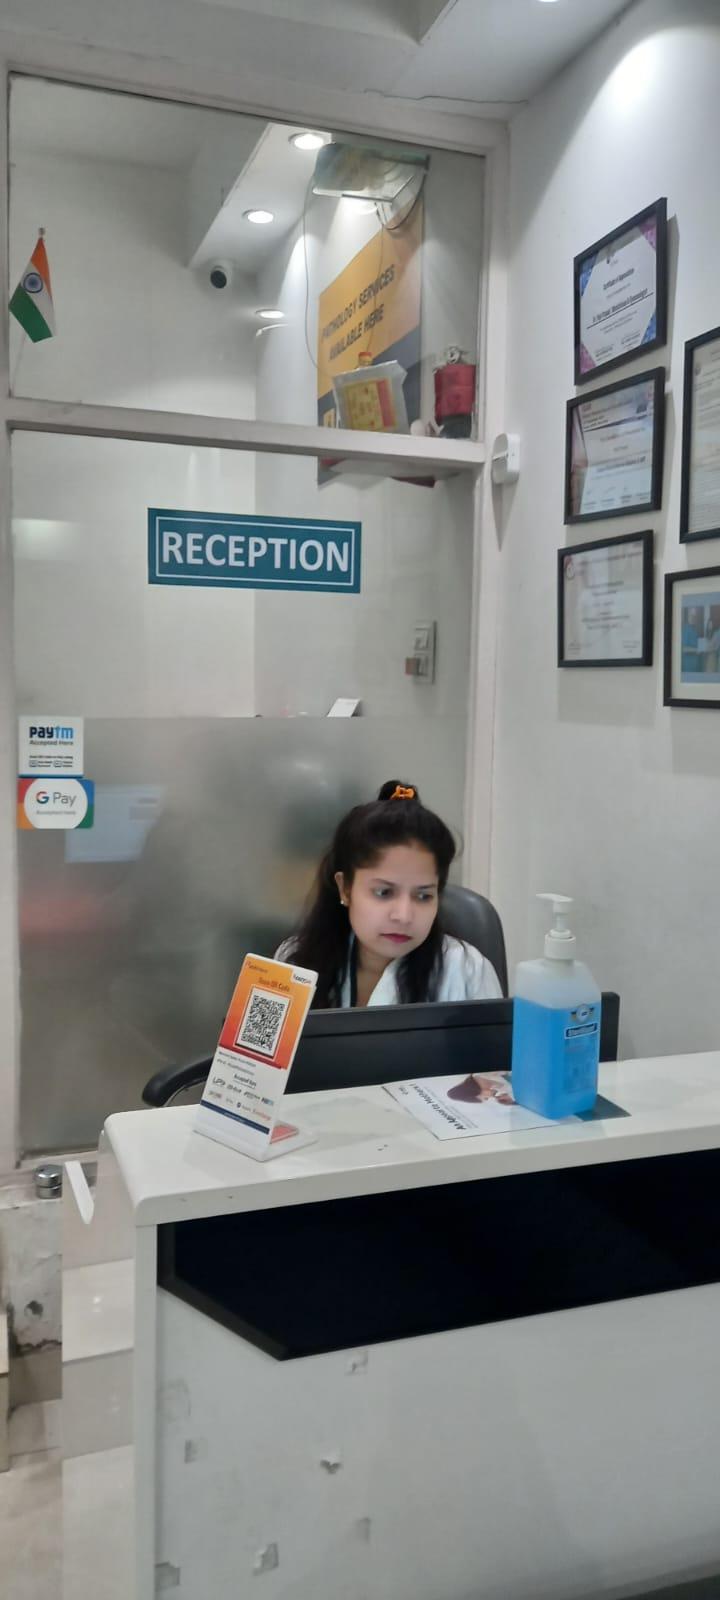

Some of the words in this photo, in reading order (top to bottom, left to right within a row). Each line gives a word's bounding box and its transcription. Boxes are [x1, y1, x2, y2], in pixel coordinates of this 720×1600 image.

[358, 264, 395, 309] SERVICES
[363, 303, 385, 333] HERE
[162, 531, 349, 572] RECEPTION
[36, 791, 50, 804] G
[53, 792, 77, 807] Pay
